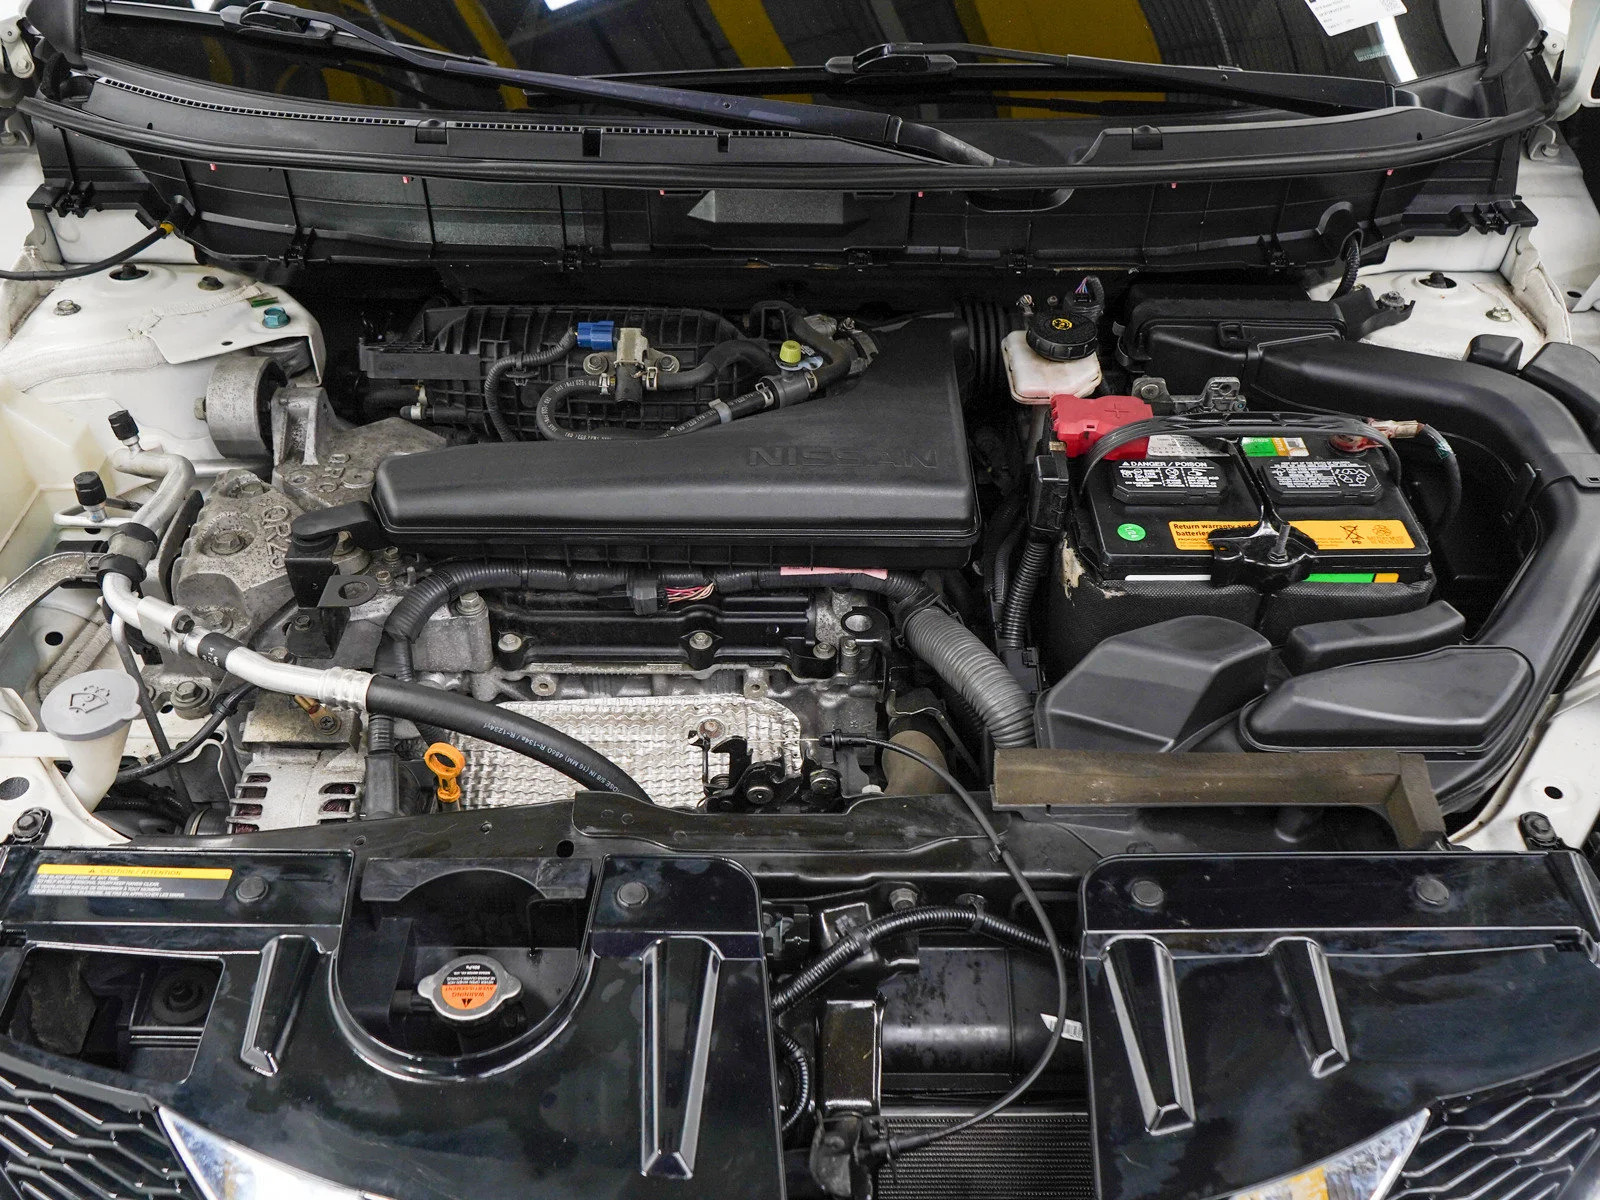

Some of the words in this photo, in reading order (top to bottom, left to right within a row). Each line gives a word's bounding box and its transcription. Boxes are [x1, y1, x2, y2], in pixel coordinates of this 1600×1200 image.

[749, 446, 938, 468] NISSAN
[482, 722, 516, 738] R-1234yf
[521, 735, 546, 751] R-134a
[564, 755, 579, 767] MM)
[579, 763, 589, 773] (16
[597, 774, 606, 784] 5/8
